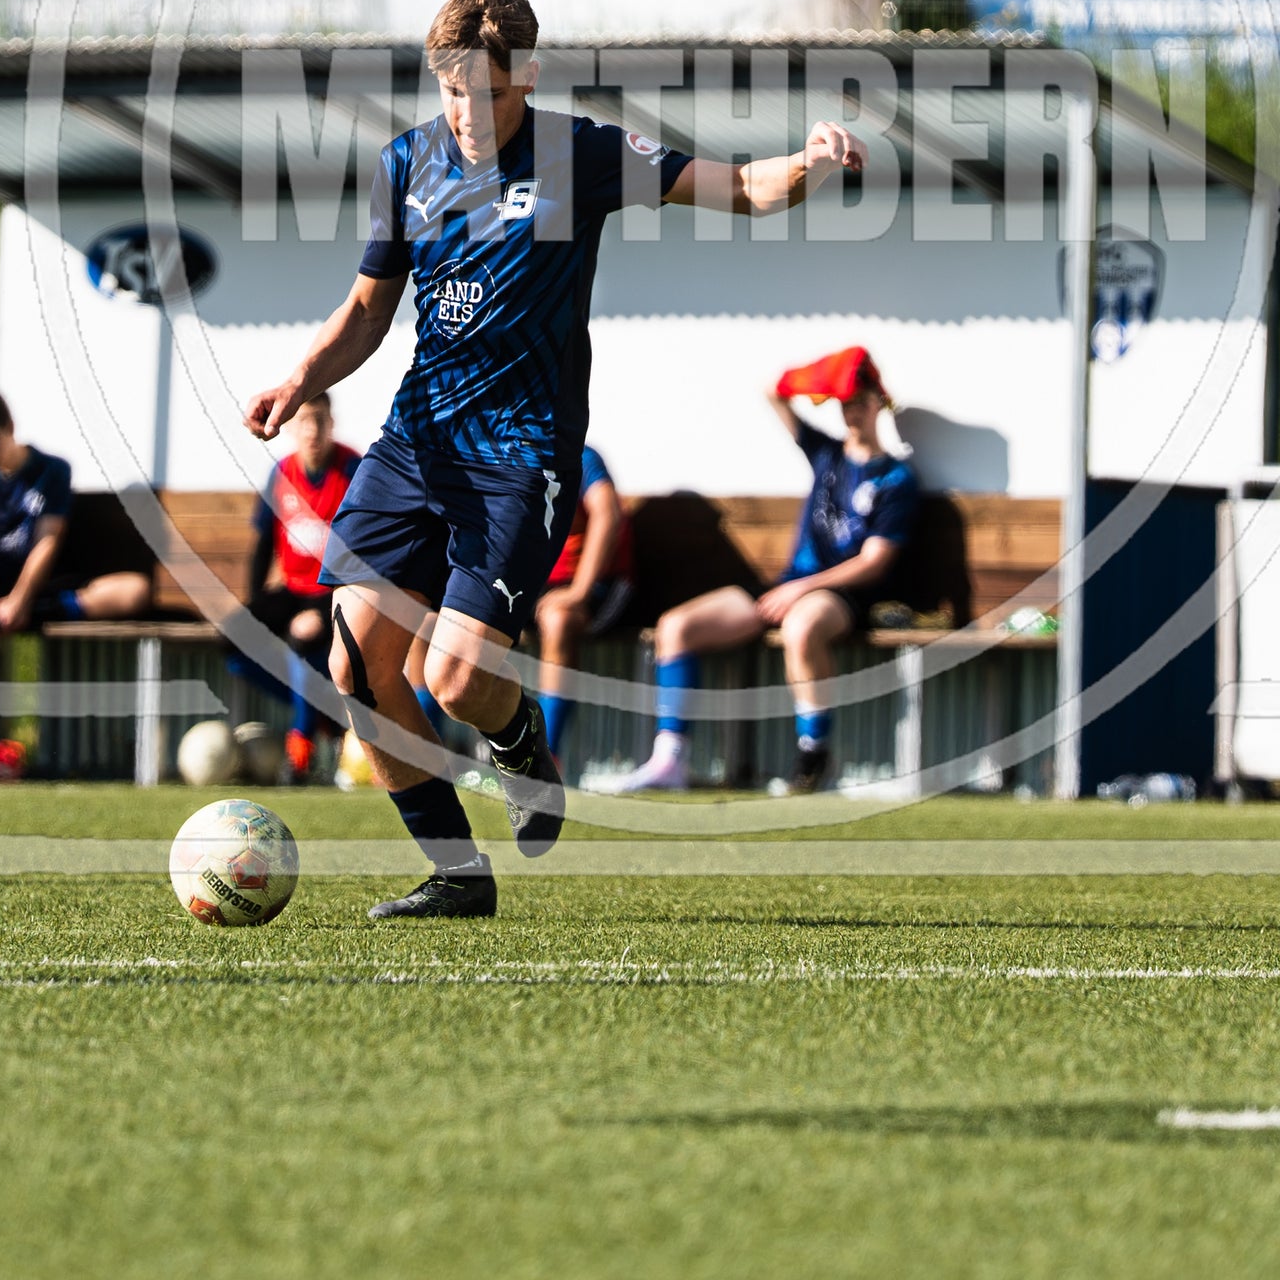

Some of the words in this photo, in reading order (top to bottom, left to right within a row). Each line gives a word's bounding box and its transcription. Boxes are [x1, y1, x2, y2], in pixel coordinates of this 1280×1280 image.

[432, 280, 483, 303] LAND
[438, 299, 474, 324] EIS
[201, 867, 263, 916] DERBYSTAR
